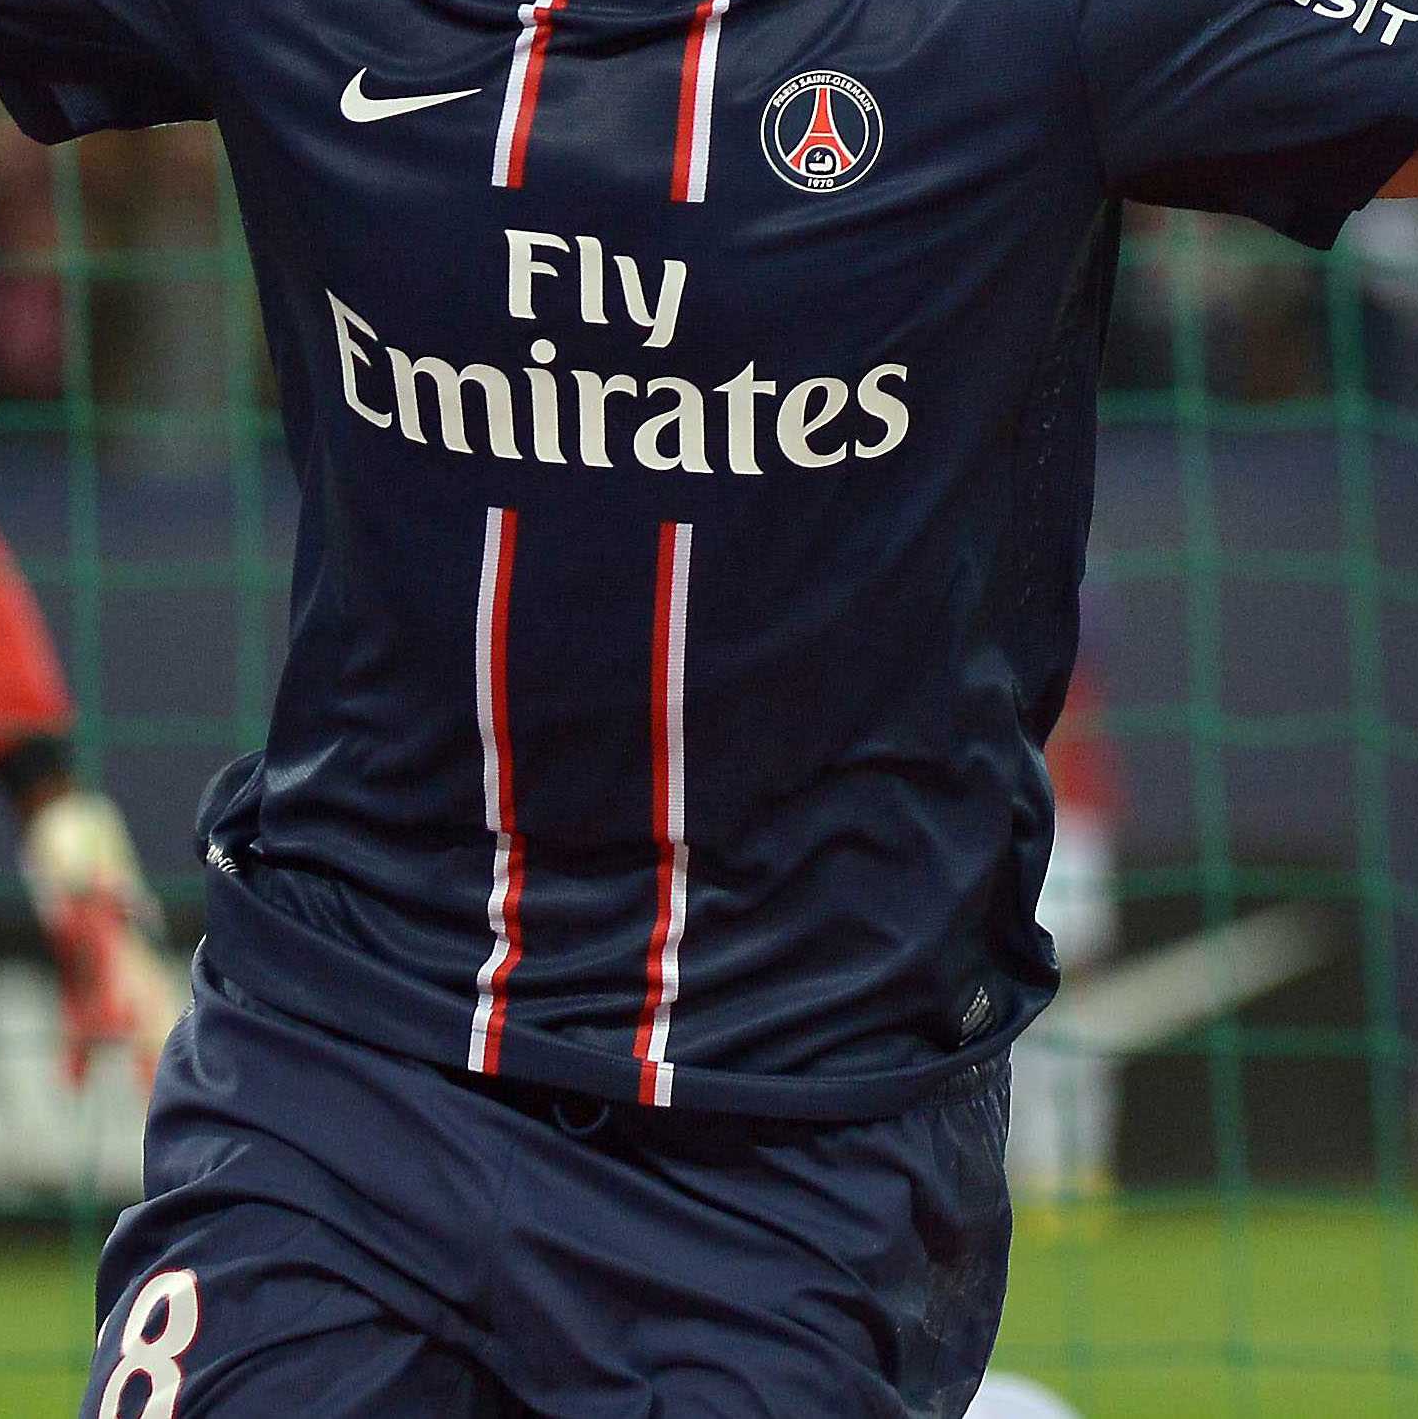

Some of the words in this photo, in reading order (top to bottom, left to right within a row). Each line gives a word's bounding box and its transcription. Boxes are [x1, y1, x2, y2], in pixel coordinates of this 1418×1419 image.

[807, 178, 835, 188] 1970
[505, 229, 688, 348] Fly
[325, 286, 909, 476] Emirates
[97, 1268, 201, 1419] 8
